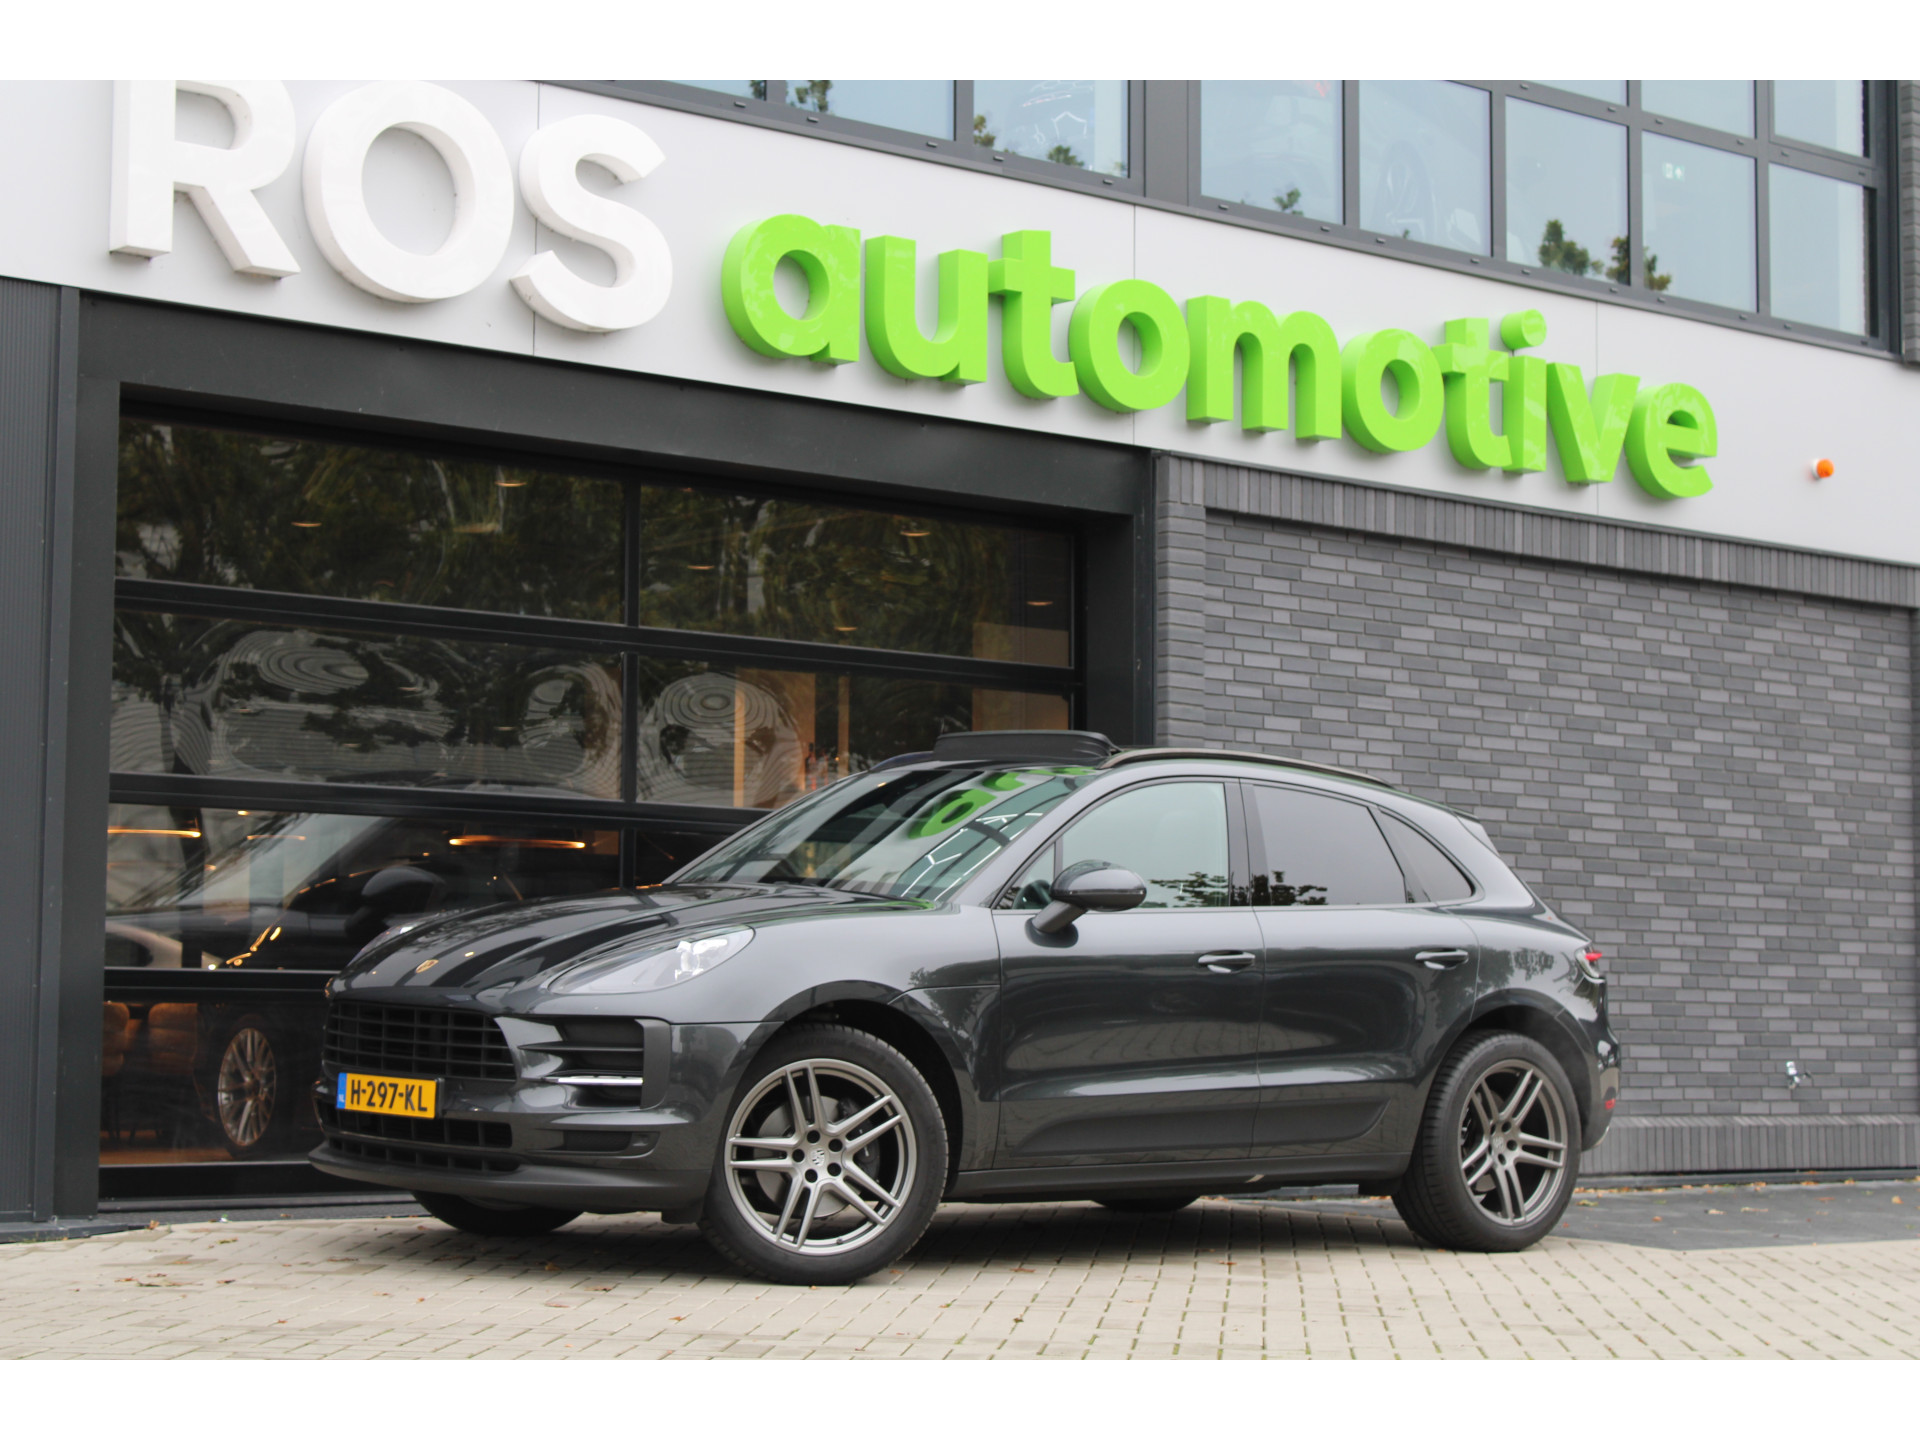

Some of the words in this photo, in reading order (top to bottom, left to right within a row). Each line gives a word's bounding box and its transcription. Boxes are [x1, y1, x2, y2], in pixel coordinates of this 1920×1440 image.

[109, 80, 673, 332] ROS
[721, 213, 1718, 498] automotive
[350, 1079, 428, 1112] H-297-KL
